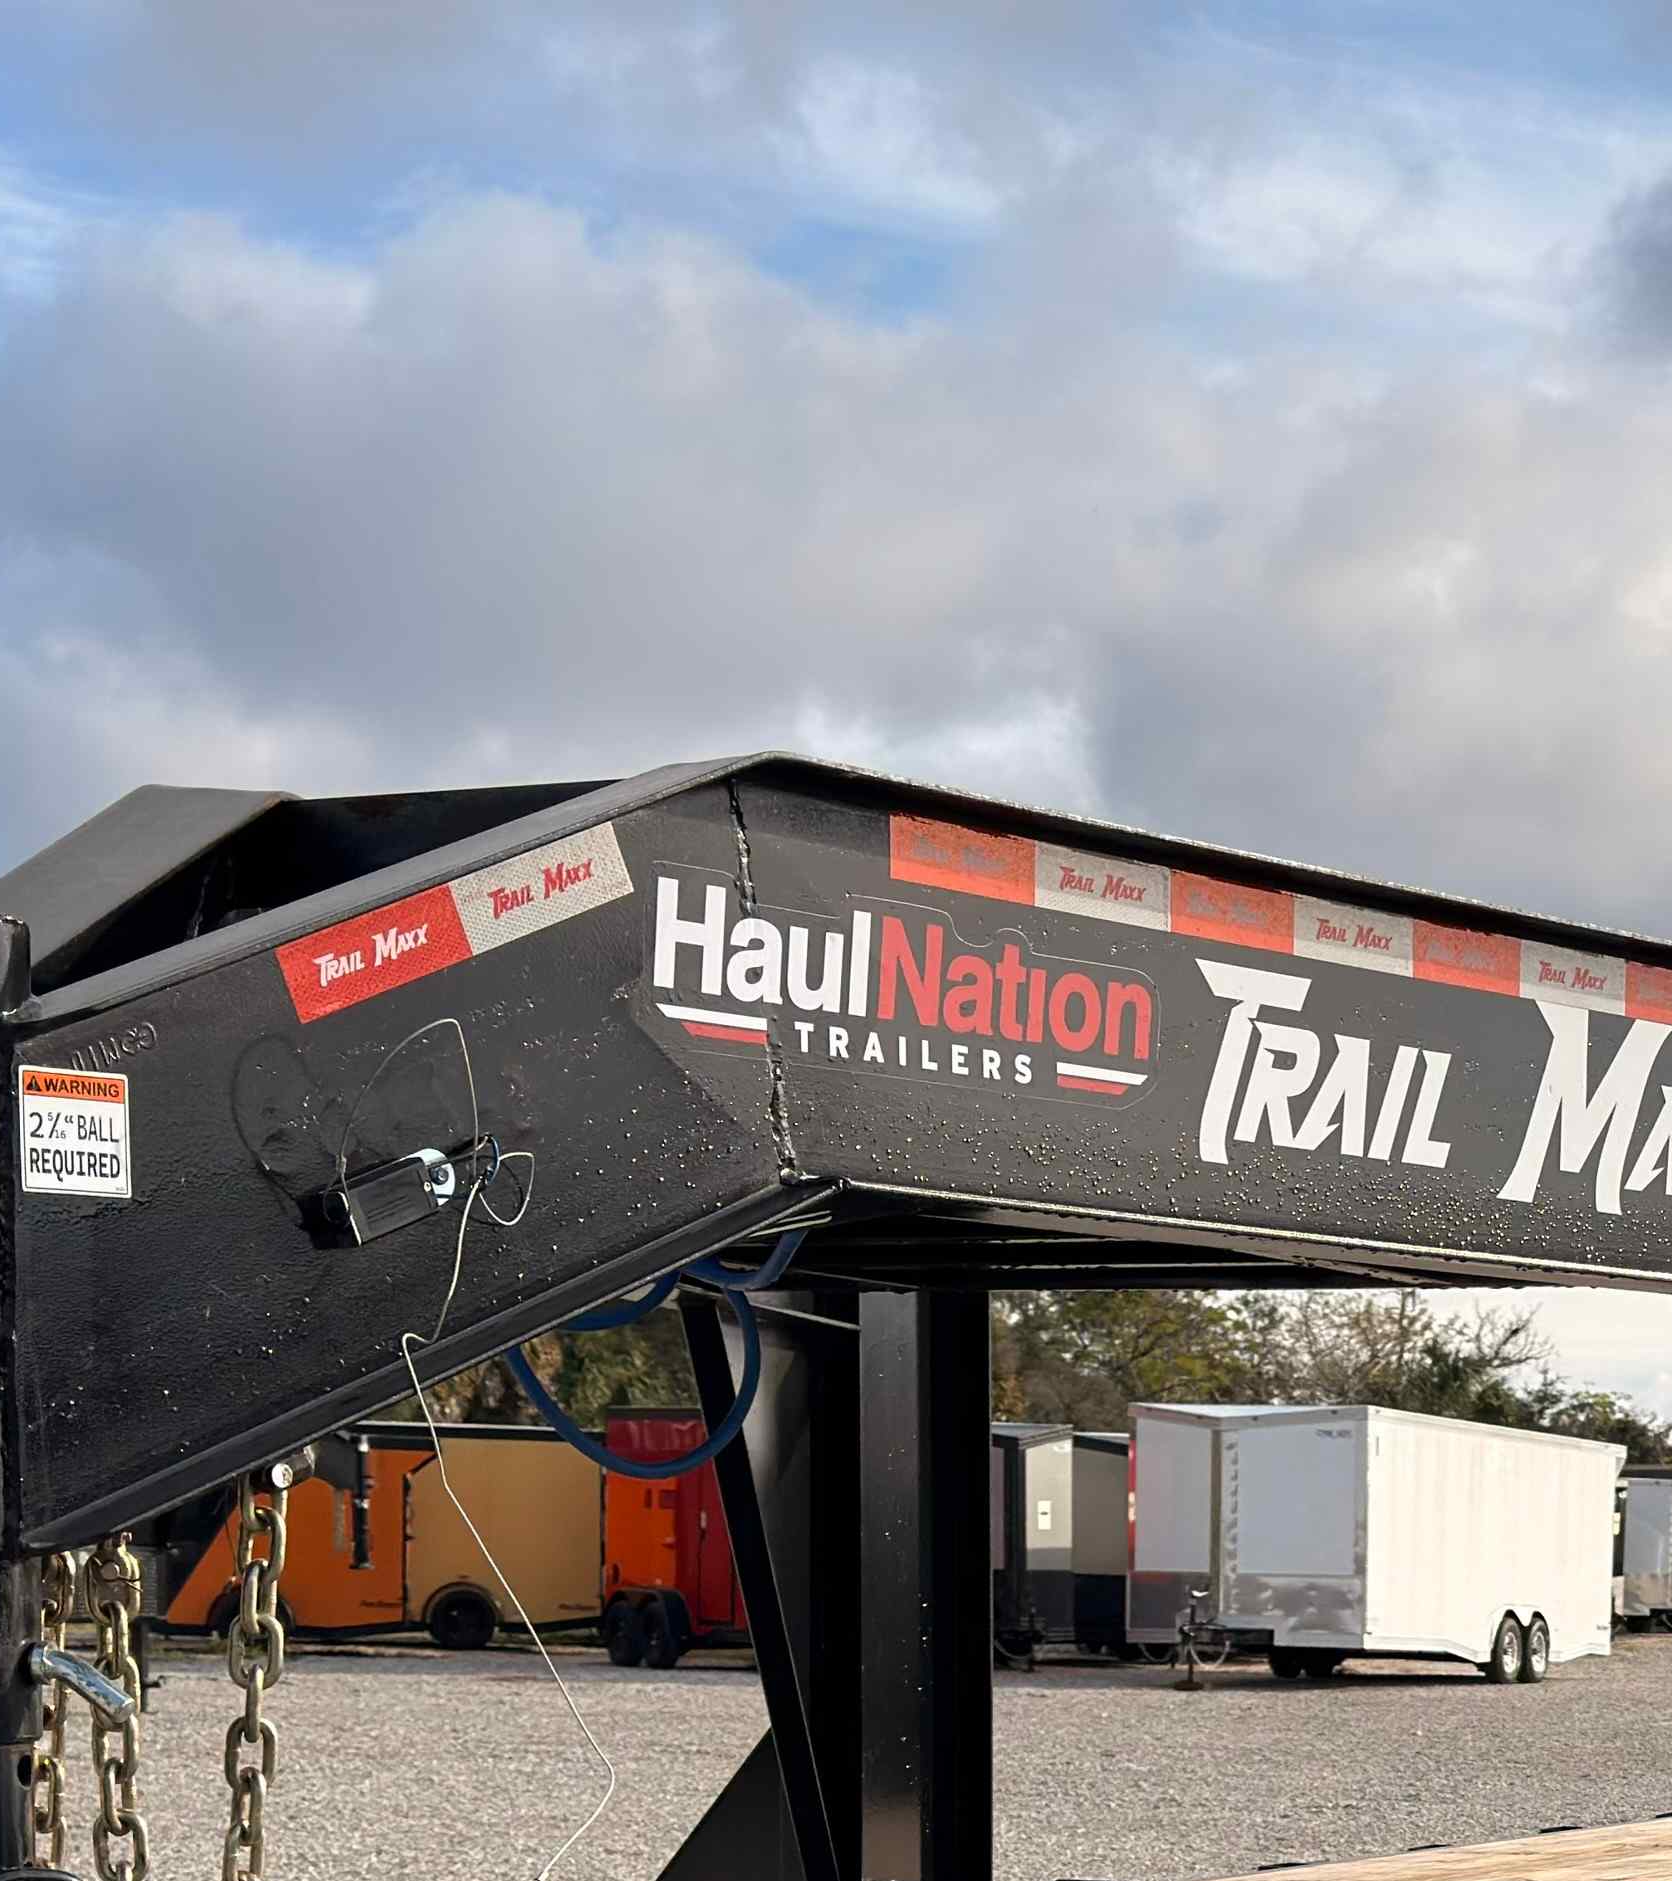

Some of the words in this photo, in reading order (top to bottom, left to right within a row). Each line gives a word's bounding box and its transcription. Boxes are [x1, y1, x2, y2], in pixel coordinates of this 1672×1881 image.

[312, 952, 365, 988] TRAIL
[372, 923, 428, 968] MAXX
[653, 876, 1154, 1060] HaulNation
[794, 1020, 1033, 1084] TRAILERS
[1194, 958, 1452, 1169] TRAIL
[44, 1078, 120, 1098] WARNING
[78, 1114, 120, 1143] BALL
[29, 1147, 120, 1182] REQUIRED
